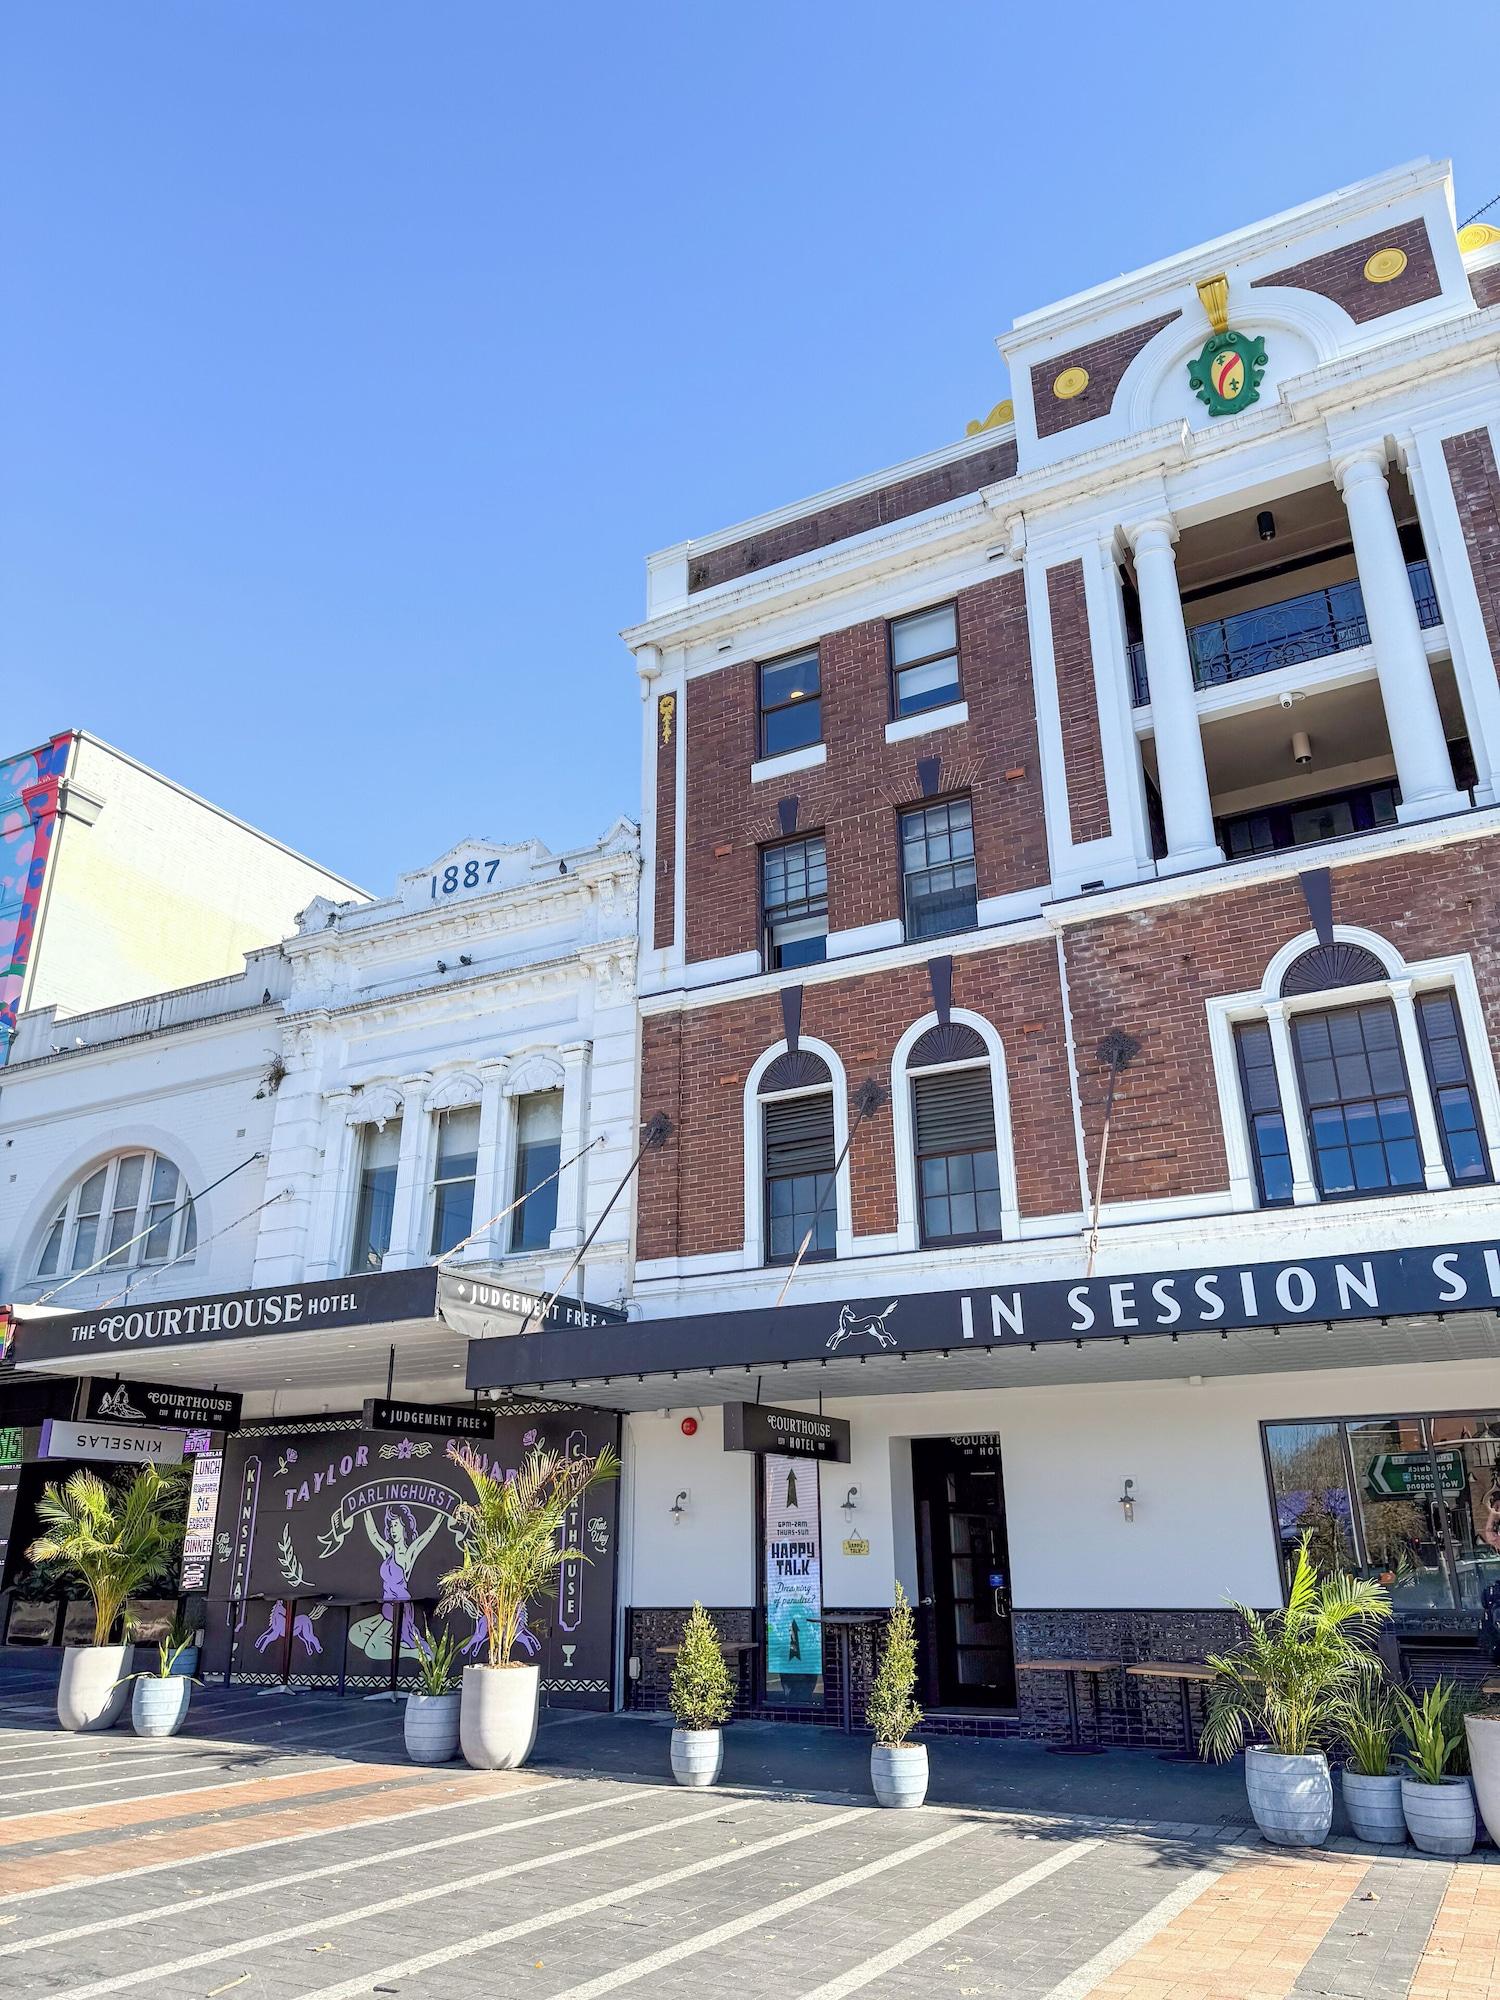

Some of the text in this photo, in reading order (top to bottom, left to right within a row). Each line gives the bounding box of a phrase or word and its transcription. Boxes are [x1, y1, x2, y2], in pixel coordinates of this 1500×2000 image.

[431, 859, 500, 899] 1887
[469, 1284, 598, 1327] JUDGEMENT FREE
[961, 1292, 1024, 1338] IN
[1067, 1261, 1379, 1331] SESSION
[71, 1293, 358, 1342] THE COURTHOUSE HOTEL
[147, 1392, 233, 1412] COURTHOUSE
[174, 1409, 208, 1422] HOTEL
[390, 1409, 481, 1429] JUDGEMENT FREE
[767, 1415, 831, 1438] COURTHOUSE
[76, 1435, 162, 1453] KINSELAS
[789, 1436, 815, 1451] HOTEL
[195, 1460, 221, 1475] LUNCH
[284, 1438, 519, 1510] TAYLOR SQUAR
[196, 1496, 210, 1513] $15
[347, 1483, 455, 1512] DARLINGHURST
[188, 1522, 211, 1530] CAESAR
[566, 1444, 581, 1614] CRTHUSE
[587, 1517, 607, 1533] That
[184, 1539, 212, 1553] DINNER
[233, 1468, 256, 1614] KINSELA
[591, 1529, 610, 1547] Way
[771, 1542, 815, 1559] HAPPY
[776, 1559, 810, 1576] TALK
